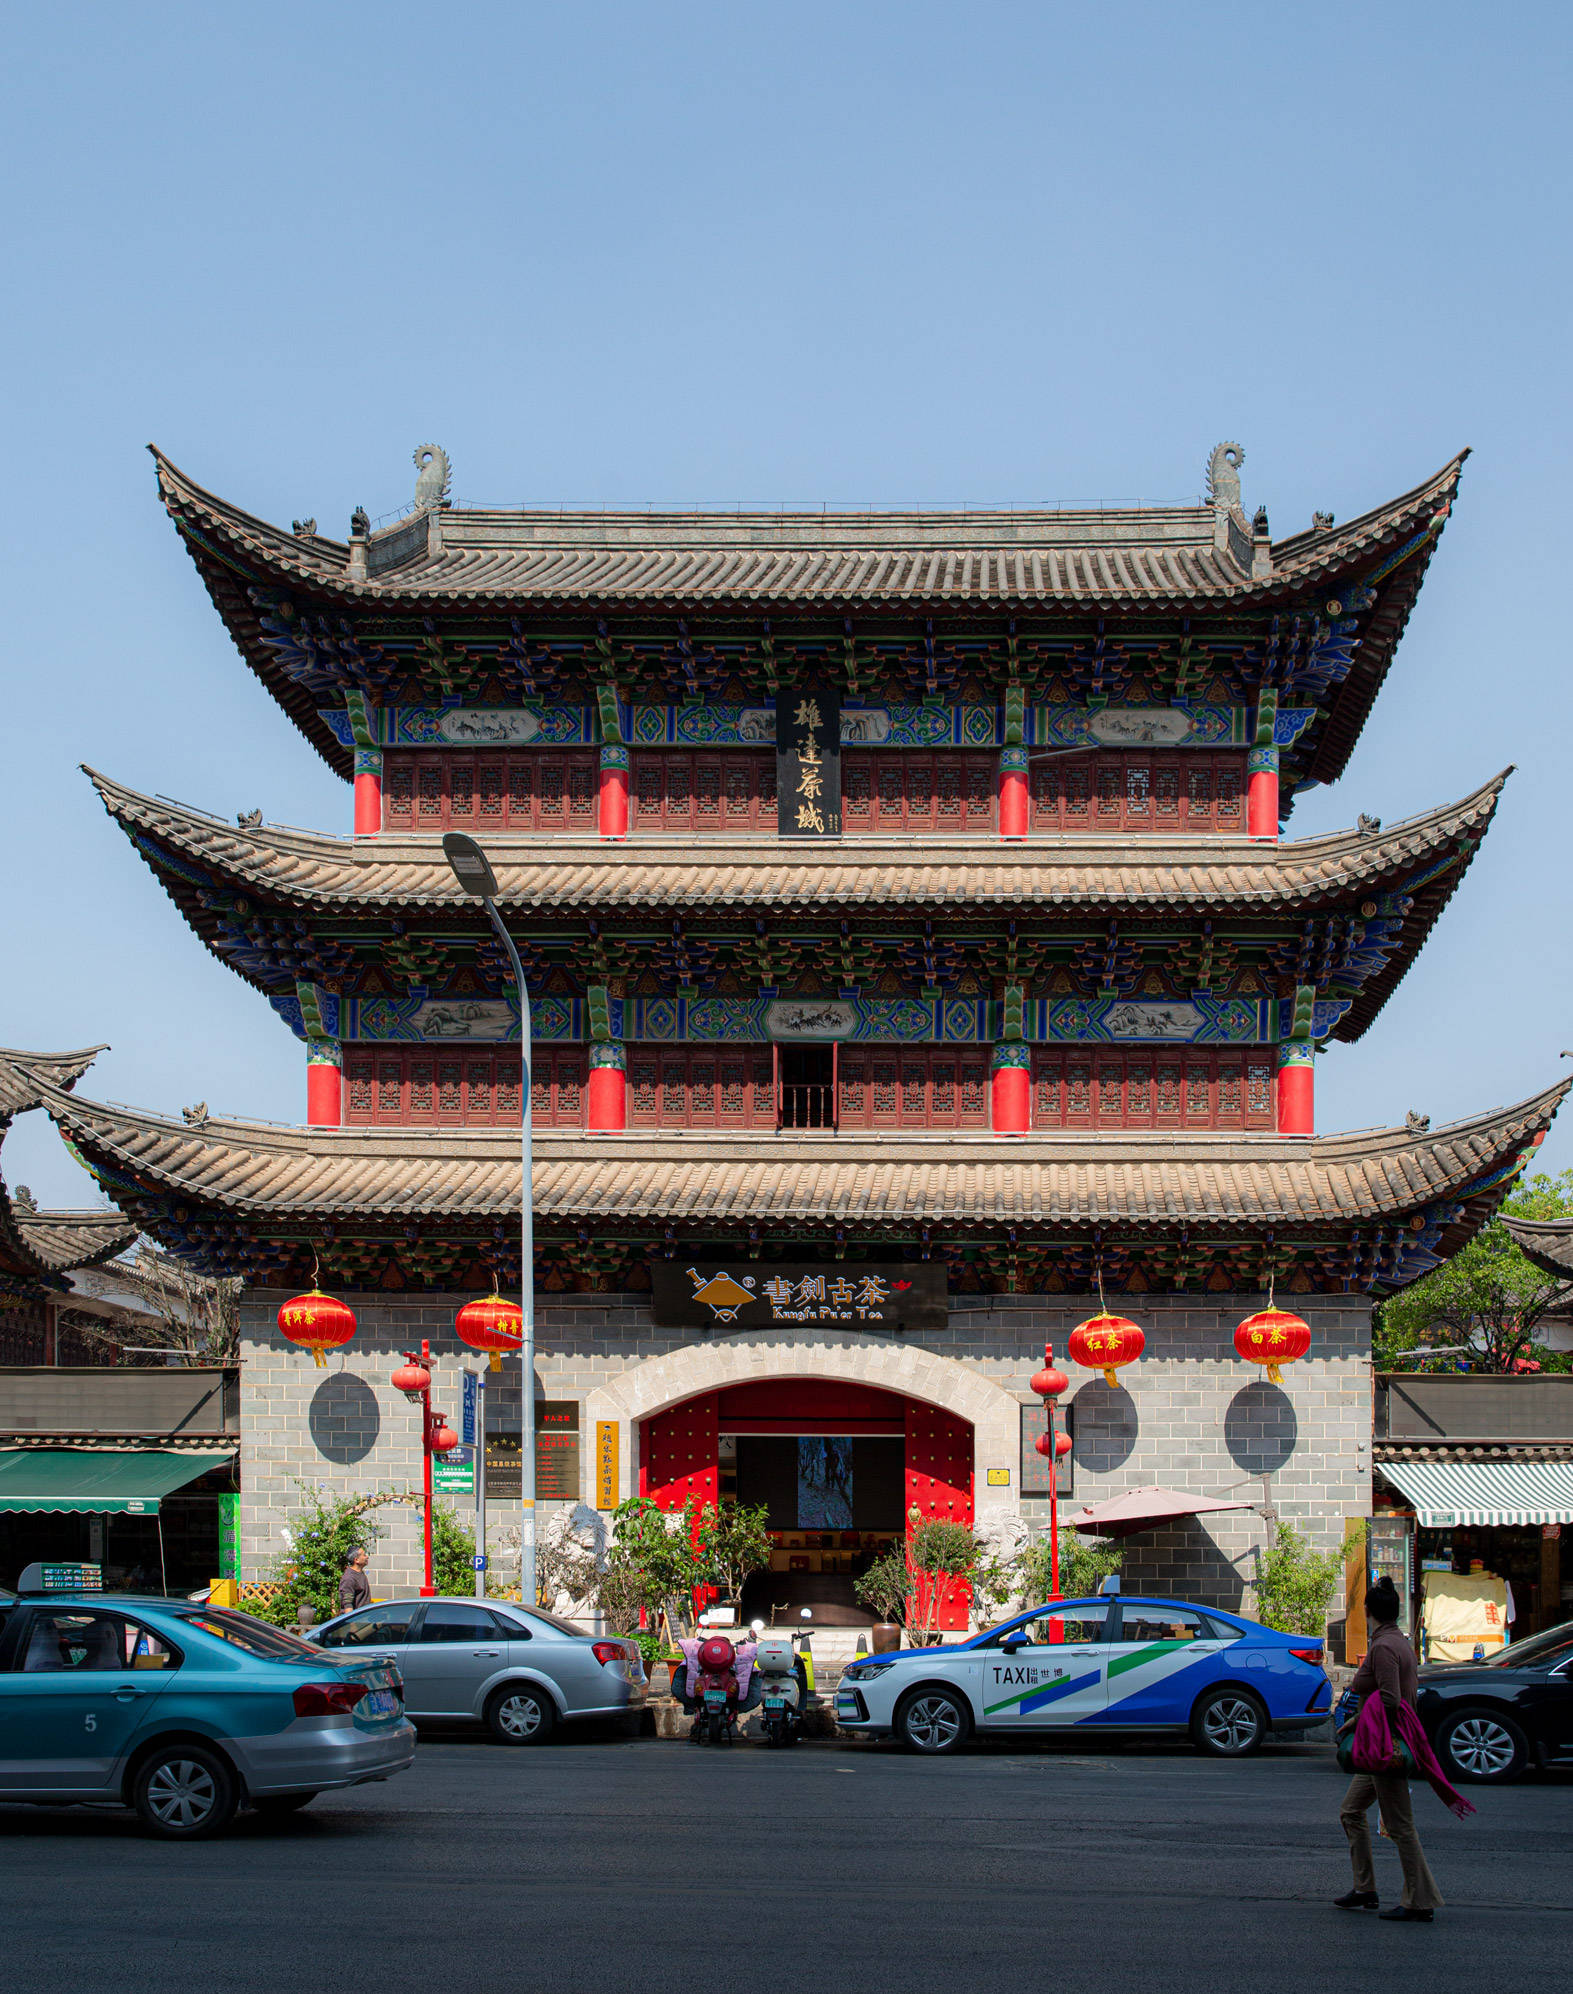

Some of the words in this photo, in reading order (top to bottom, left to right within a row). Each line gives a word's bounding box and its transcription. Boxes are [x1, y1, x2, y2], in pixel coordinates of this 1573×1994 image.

[762, 1275, 890, 1307] 書劍古茶
[284, 1310, 316, 1326] 普洱茶
[773, 1306, 817, 1321] Kungfu
[820, 1306, 853, 1320] Pu'er
[855, 1306, 884, 1320] Tea
[497, 1318, 523, 1335] 柑普
[1087, 1334, 1123, 1352] 红茶
[1251, 1328, 1287, 1345] 白茶
[475, 1558, 483, 1569] P
[993, 1667, 1030, 1684] TAXI
[1041, 1667, 1063, 1678] 世博
[85, 1713, 97, 1732] 5
